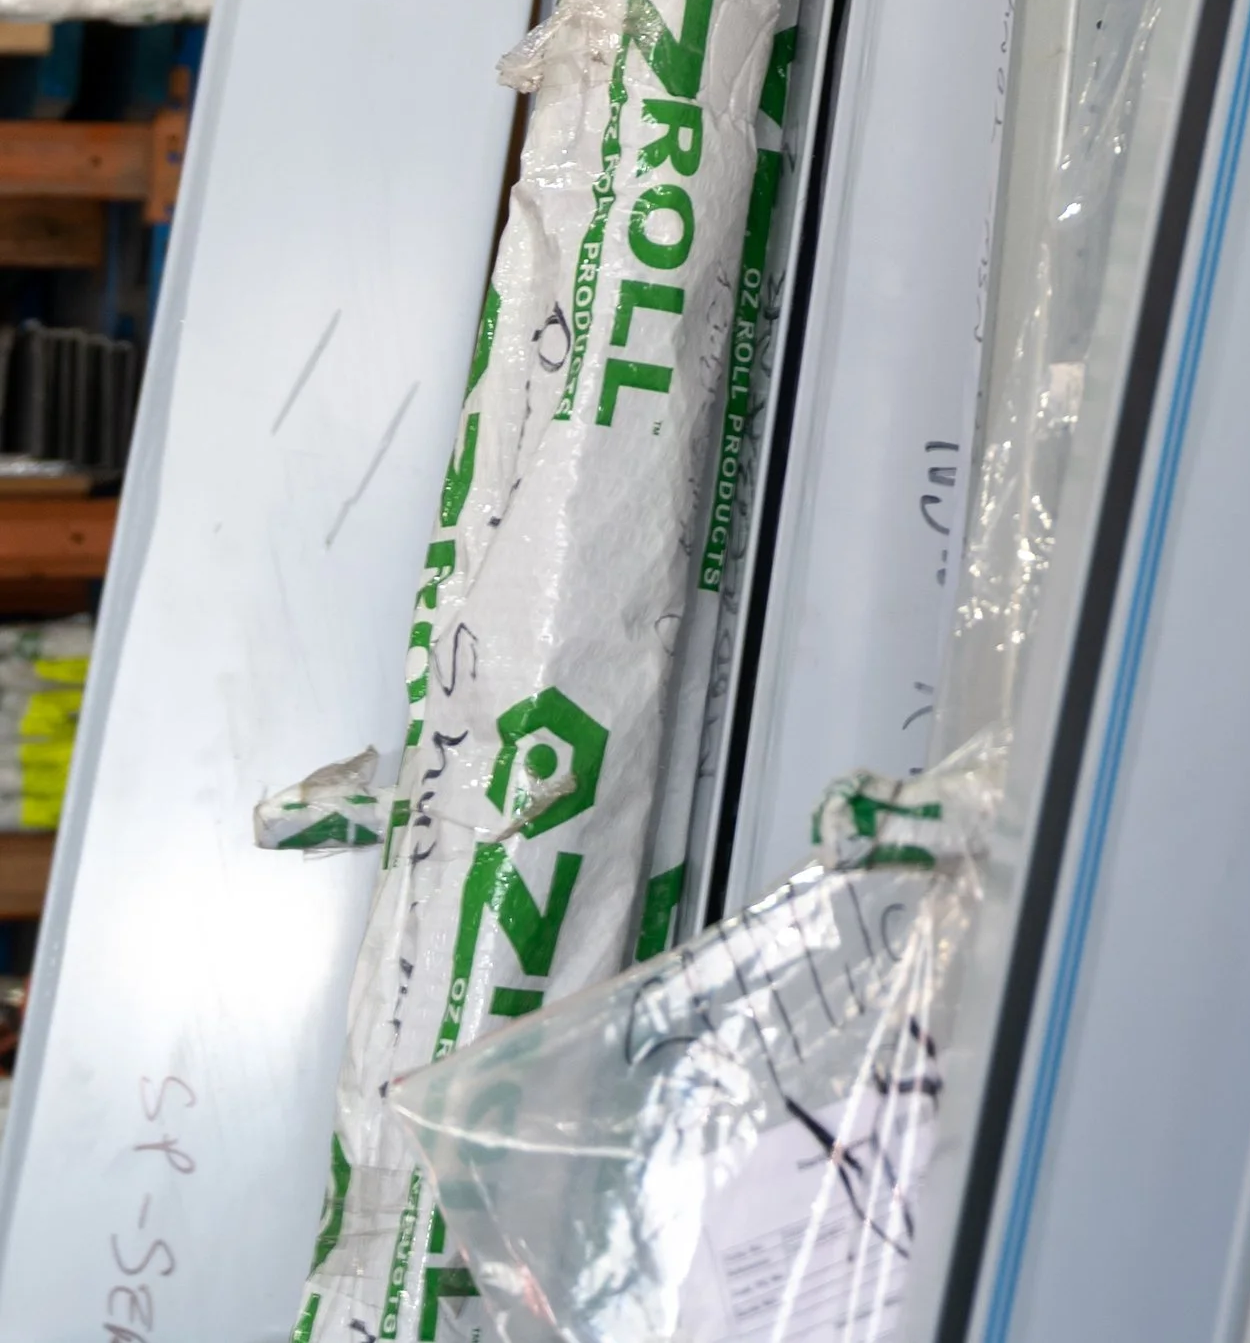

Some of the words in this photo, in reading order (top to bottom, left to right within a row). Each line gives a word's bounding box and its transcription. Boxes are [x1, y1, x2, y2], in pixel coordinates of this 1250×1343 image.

[555, 241, 601, 416] PRODUCTS
[740, 267, 760, 309] OZ
[731, 321, 755, 400] ROLL
[703, 413, 744, 588] PRODUCTS
